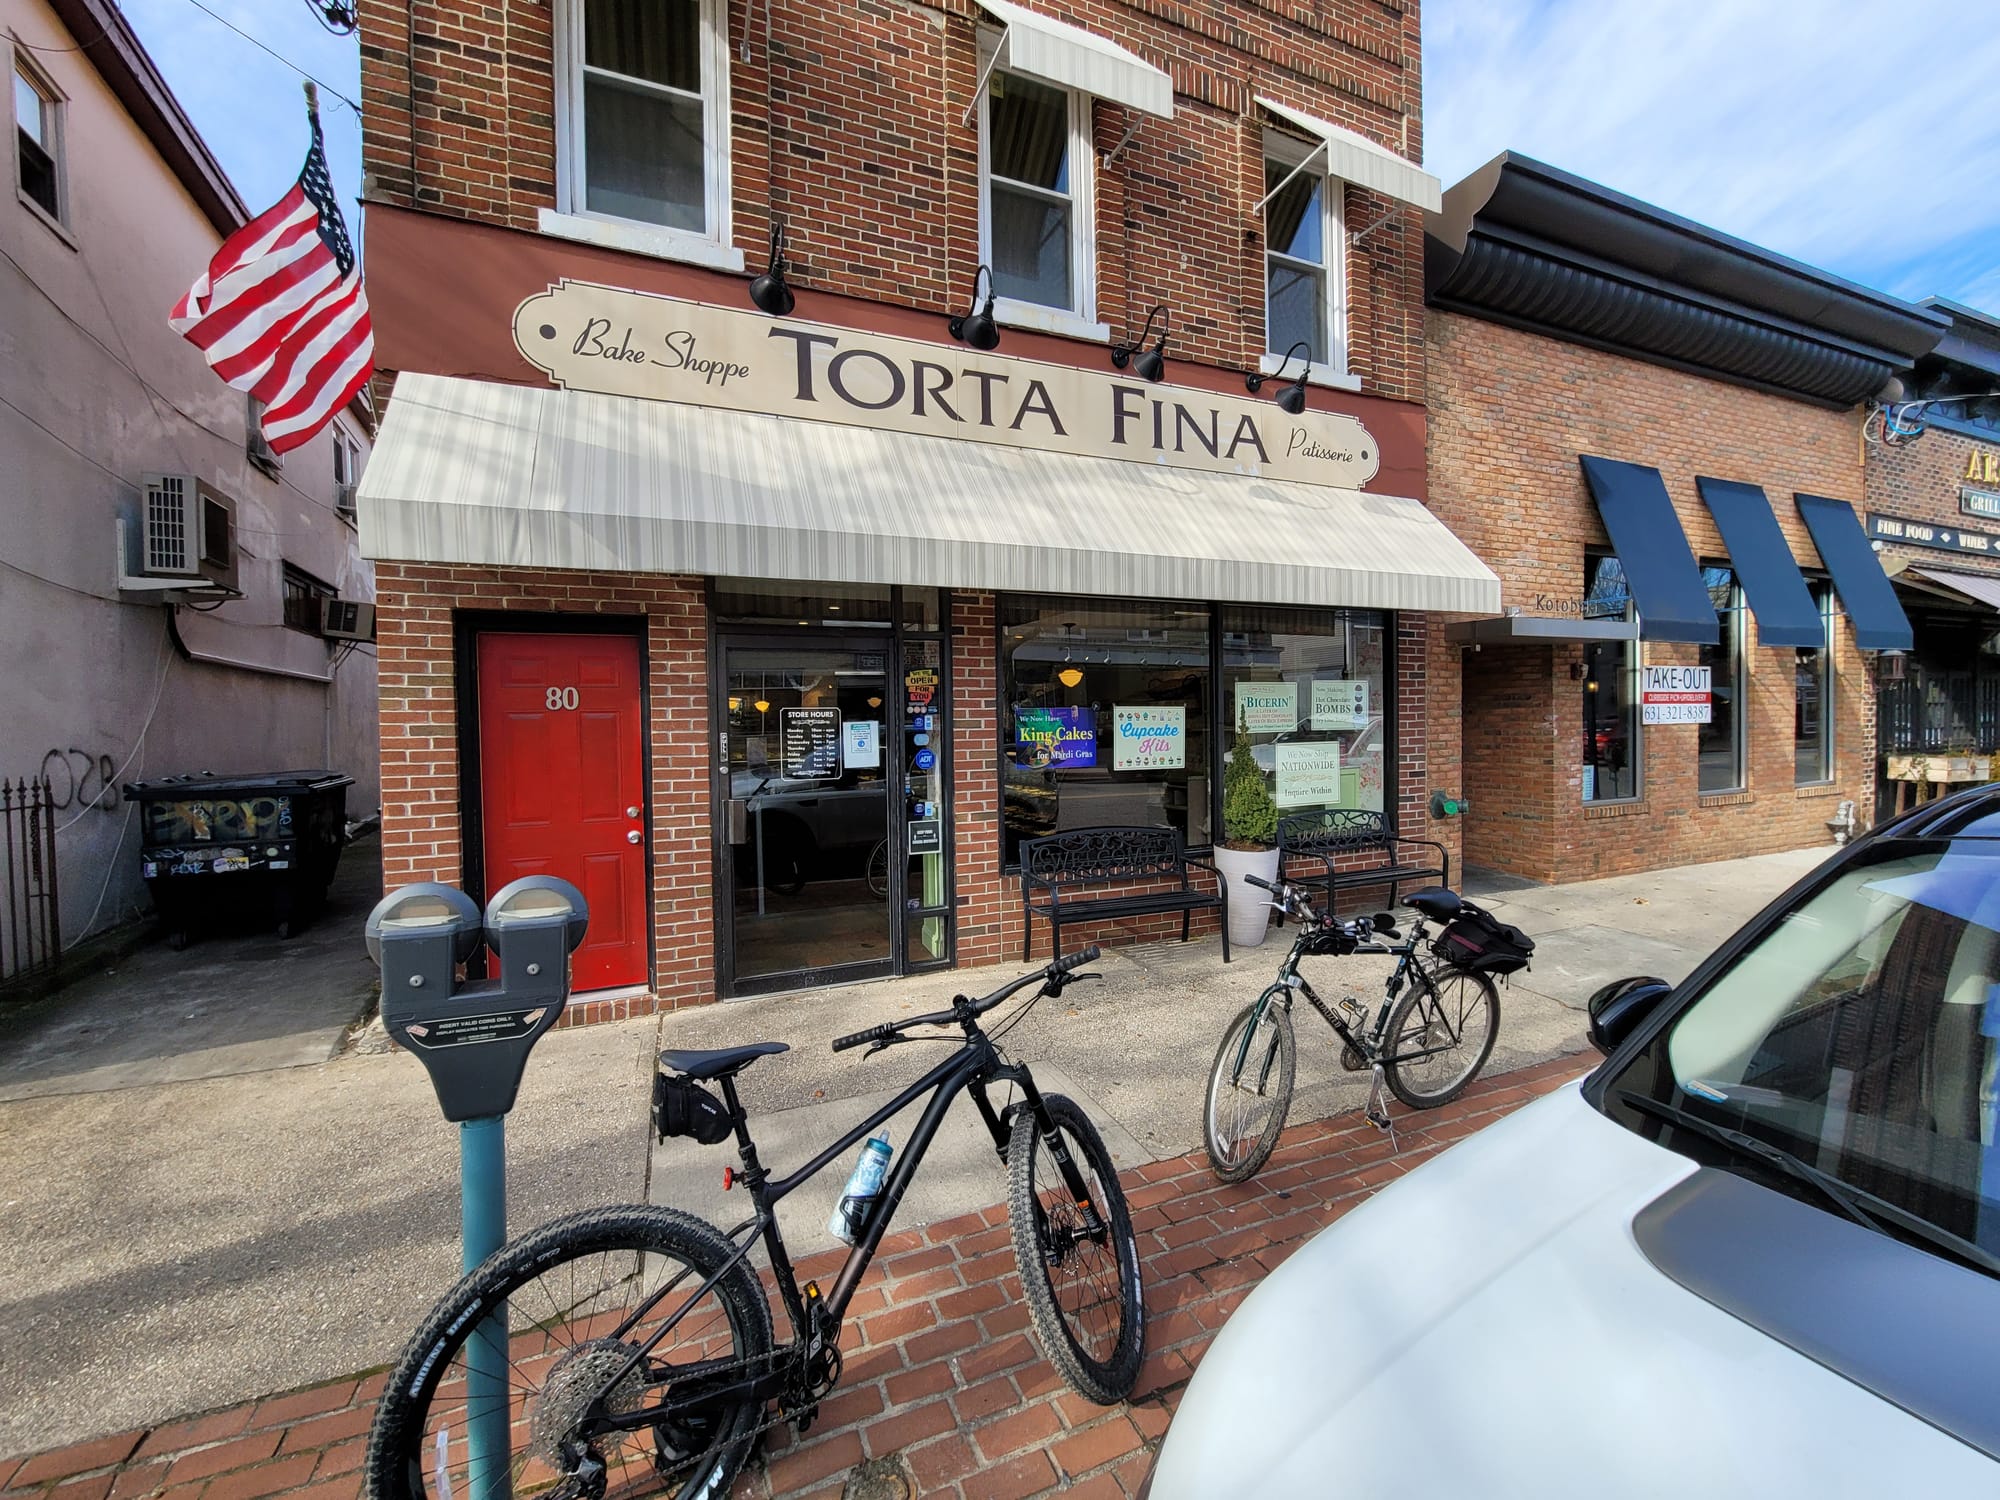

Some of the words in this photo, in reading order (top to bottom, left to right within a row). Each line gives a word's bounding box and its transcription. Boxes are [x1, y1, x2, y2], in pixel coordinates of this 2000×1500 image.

[572, 318, 645, 364] Bake
[650, 330, 750, 387] Shoppe
[768, 326, 1069, 436] TORTA
[1110, 383, 1272, 464] FINA
[1285, 427, 1354, 464] Patisserie
[1964, 449, 2000, 483] AR
[1877, 520, 1903, 537] FINE
[1905, 525, 1933, 541] FOOD
[1958, 534, 1988, 550] WINES
[910, 676, 934, 685] OPEN
[1645, 667, 1709, 689] TAKE-OUT
[546, 687, 579, 710] 80
[1315, 703, 1351, 714] BOMBS
[1644, 705, 1709, 720] 631-321-8387
[1019, 727, 1053, 746] King
[1056, 726, 1093, 741] Cakes
[1119, 722, 1179, 738] Cupcake
[1037, 751, 1049, 759] for
[1050, 750, 1073, 759] Mardi
[1075, 749, 1093, 758] Gras
[1139, 738, 1171, 756] Kits
[1287, 751, 1298, 759] We
[1314, 750, 1329, 759] Ship
[919, 755, 932, 763] ADT
[1281, 760, 1335, 772] NATIONWIDE
[1285, 787, 1309, 798] Inquire
[1310, 786, 1332, 794] Within
[1307, 990, 1341, 1028] SPECIALIZED
